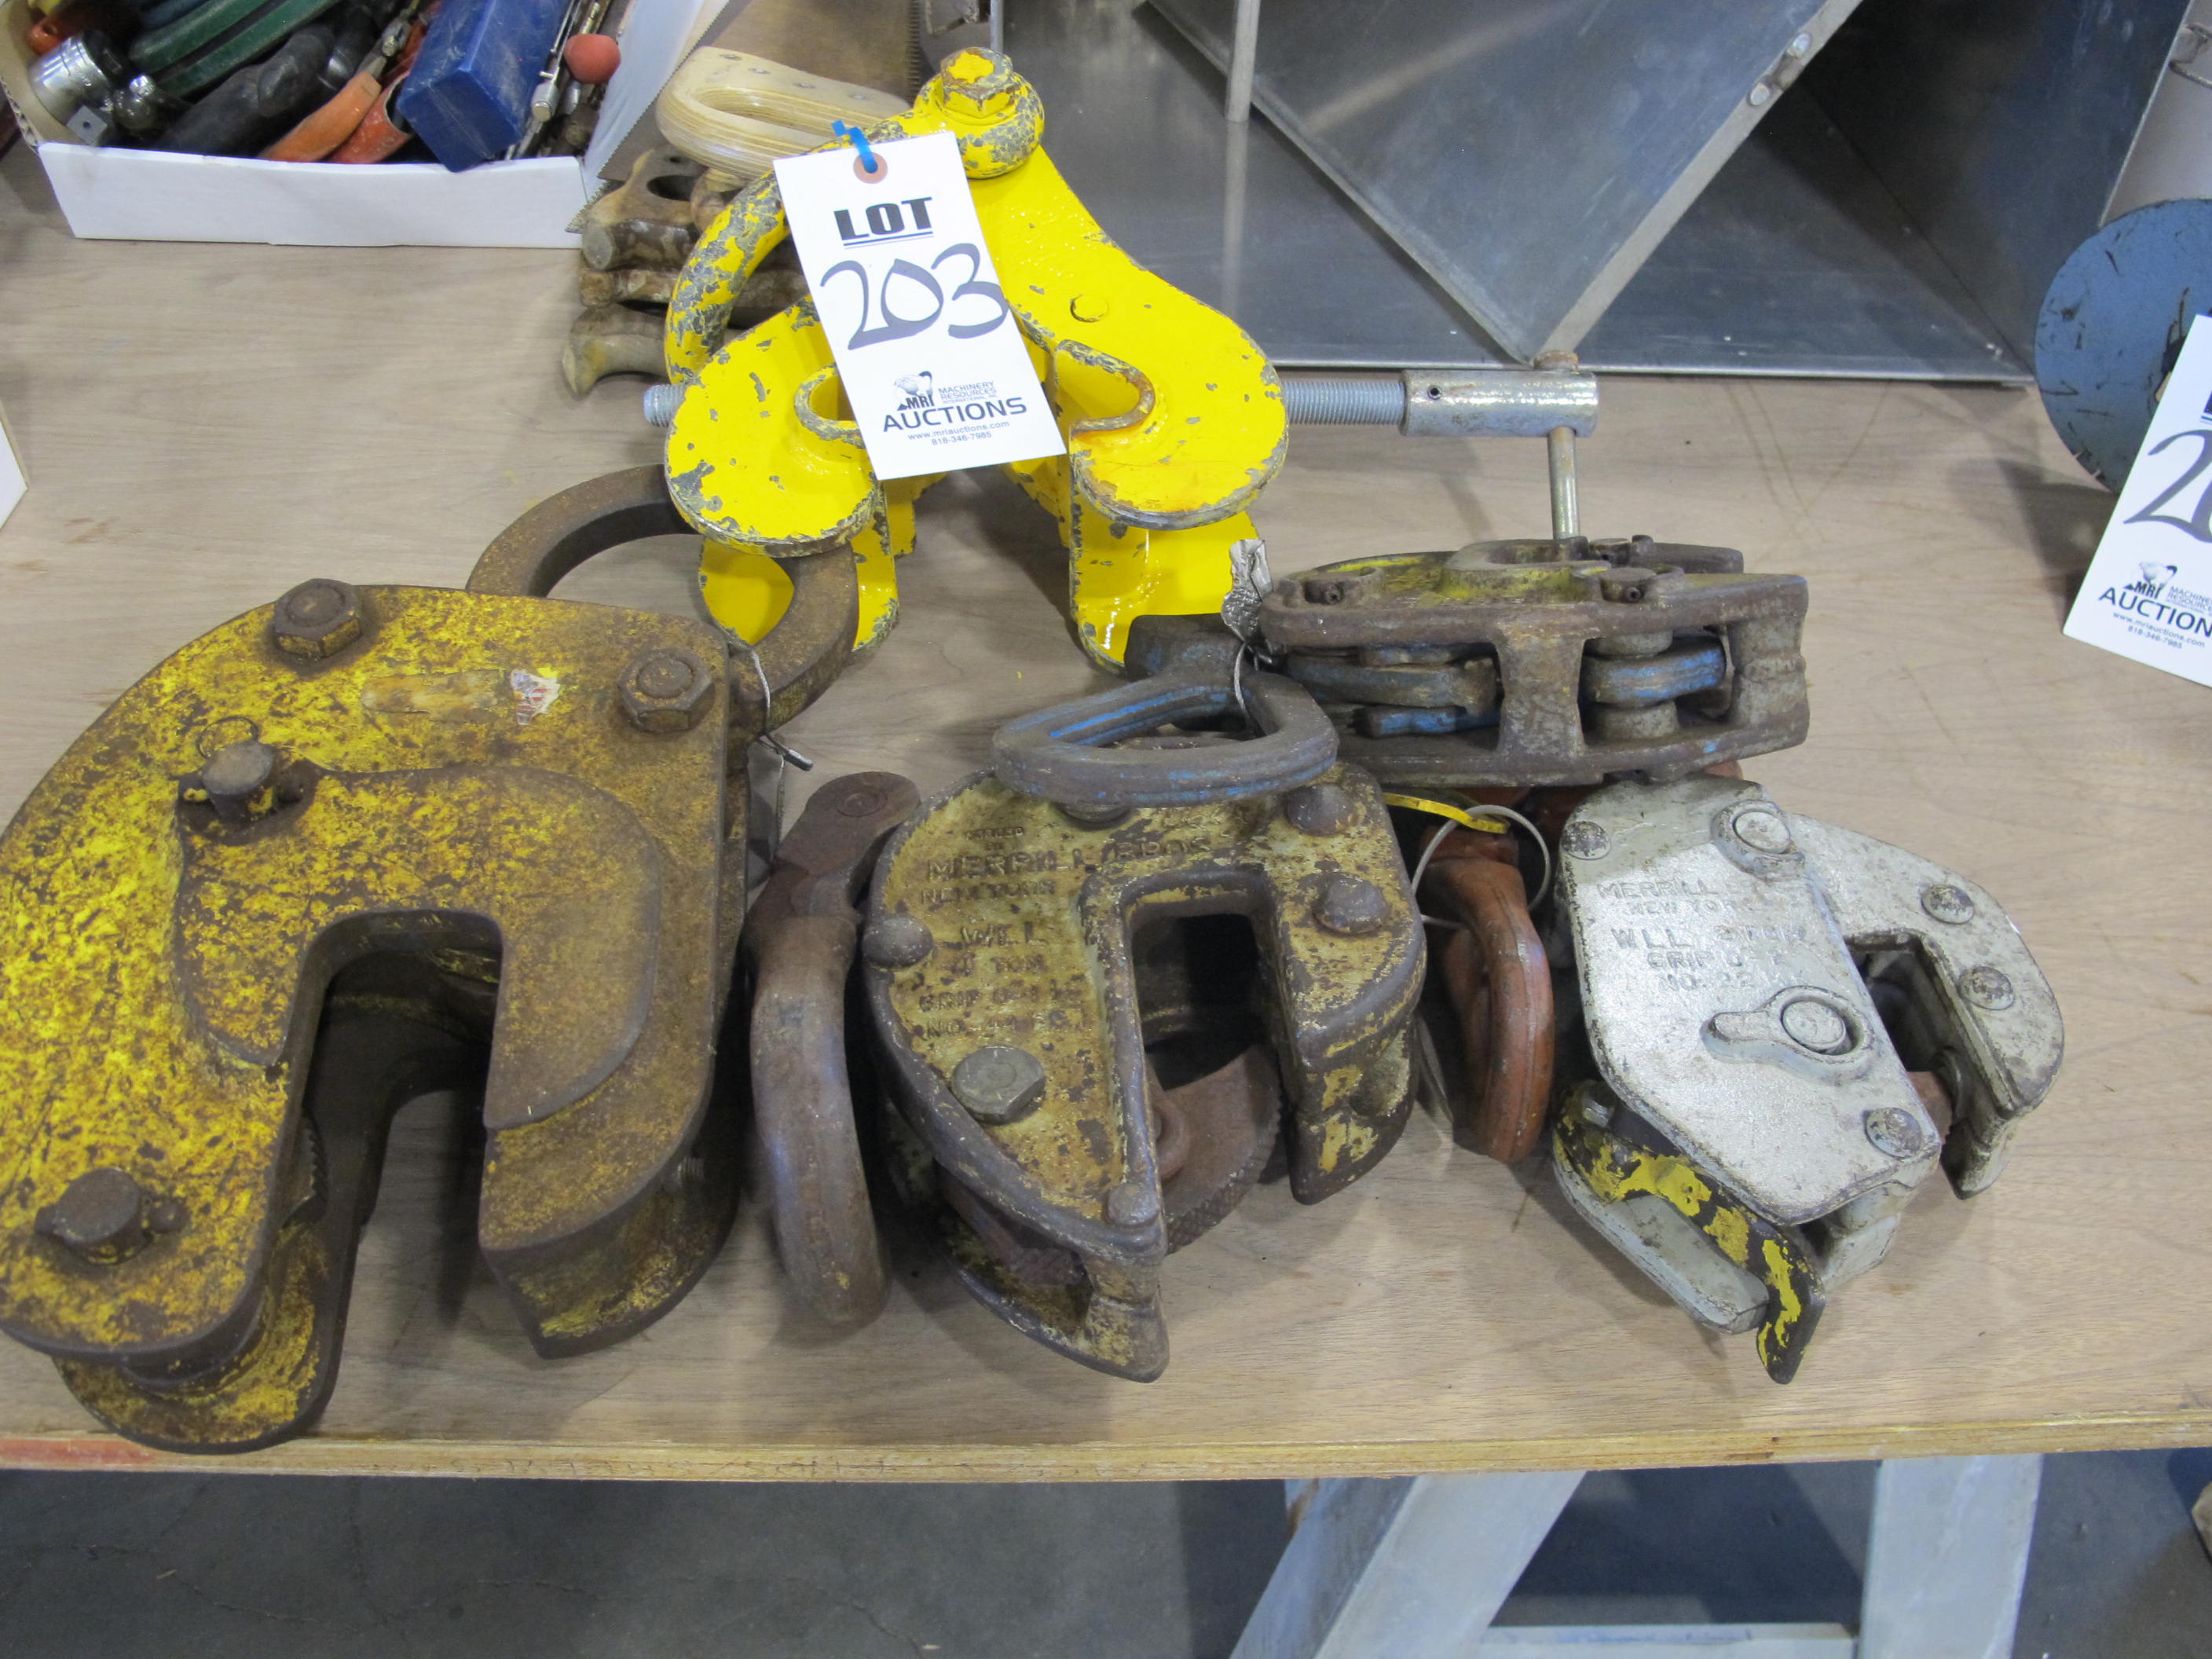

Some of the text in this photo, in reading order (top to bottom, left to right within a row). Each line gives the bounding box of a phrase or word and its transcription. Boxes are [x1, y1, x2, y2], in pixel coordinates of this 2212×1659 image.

[833, 196, 933, 240] LOT
[820, 243, 1009, 350] 203
[938, 381, 995, 394] MACHINERY
[940, 388, 998, 401] RESOURCES
[905, 394, 935, 409] MRI
[883, 397, 1027, 432] AUCTIONS
[907, 421, 1010, 440] www.mriauctions.com
[931, 431, 993, 445] 818-346-7985
[2133, 581, 2162, 599] MRI
[2170, 586, 2212, 606] MACHINE
[2113, 612, 2205, 648] www.mriauctions.com
[1597, 878, 1720, 899] MERRILL
[1646, 950, 1716, 972] GRIP
